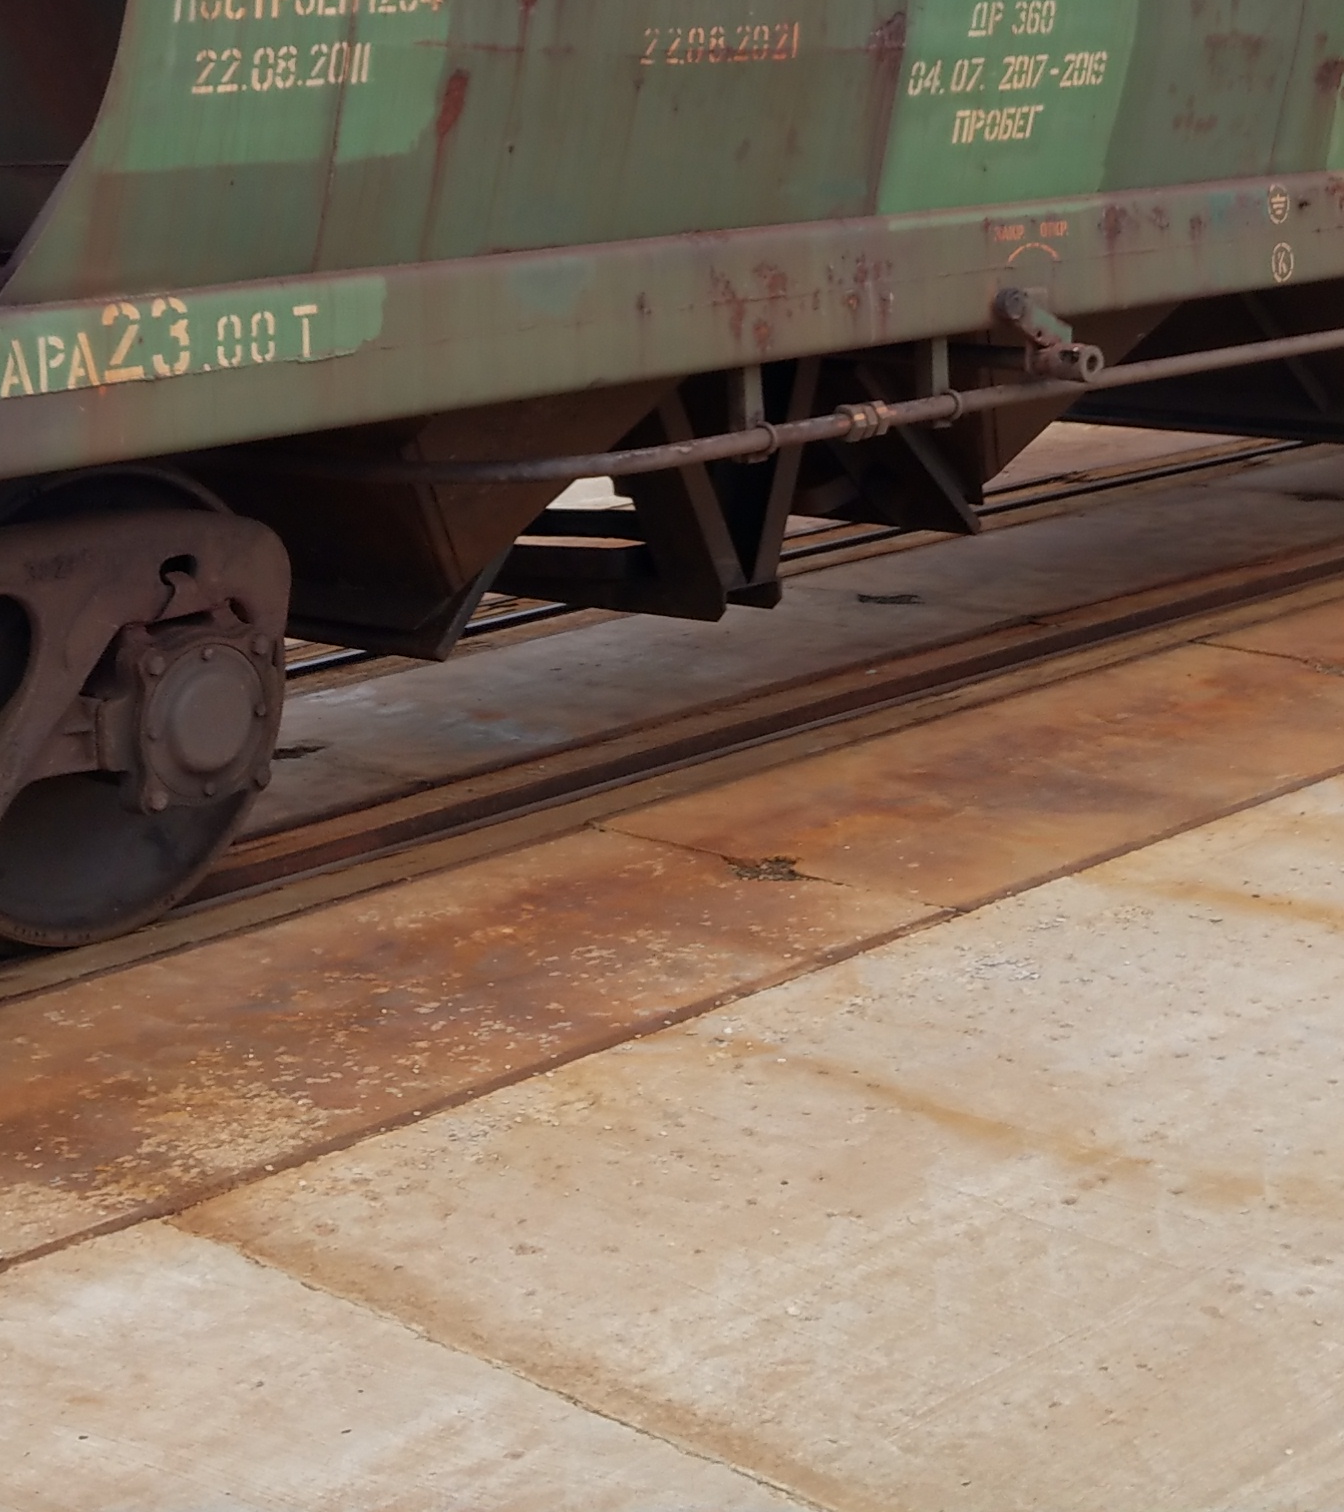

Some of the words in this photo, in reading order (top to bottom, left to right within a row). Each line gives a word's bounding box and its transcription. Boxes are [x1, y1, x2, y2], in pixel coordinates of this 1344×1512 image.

[191, 41, 372, 95] 22.08.2011
[639, 21, 800, 66] 22.08.2021
[951, 103, 1045, 145] ПРОБЕГ
[292, 294, 318, 359] Т
